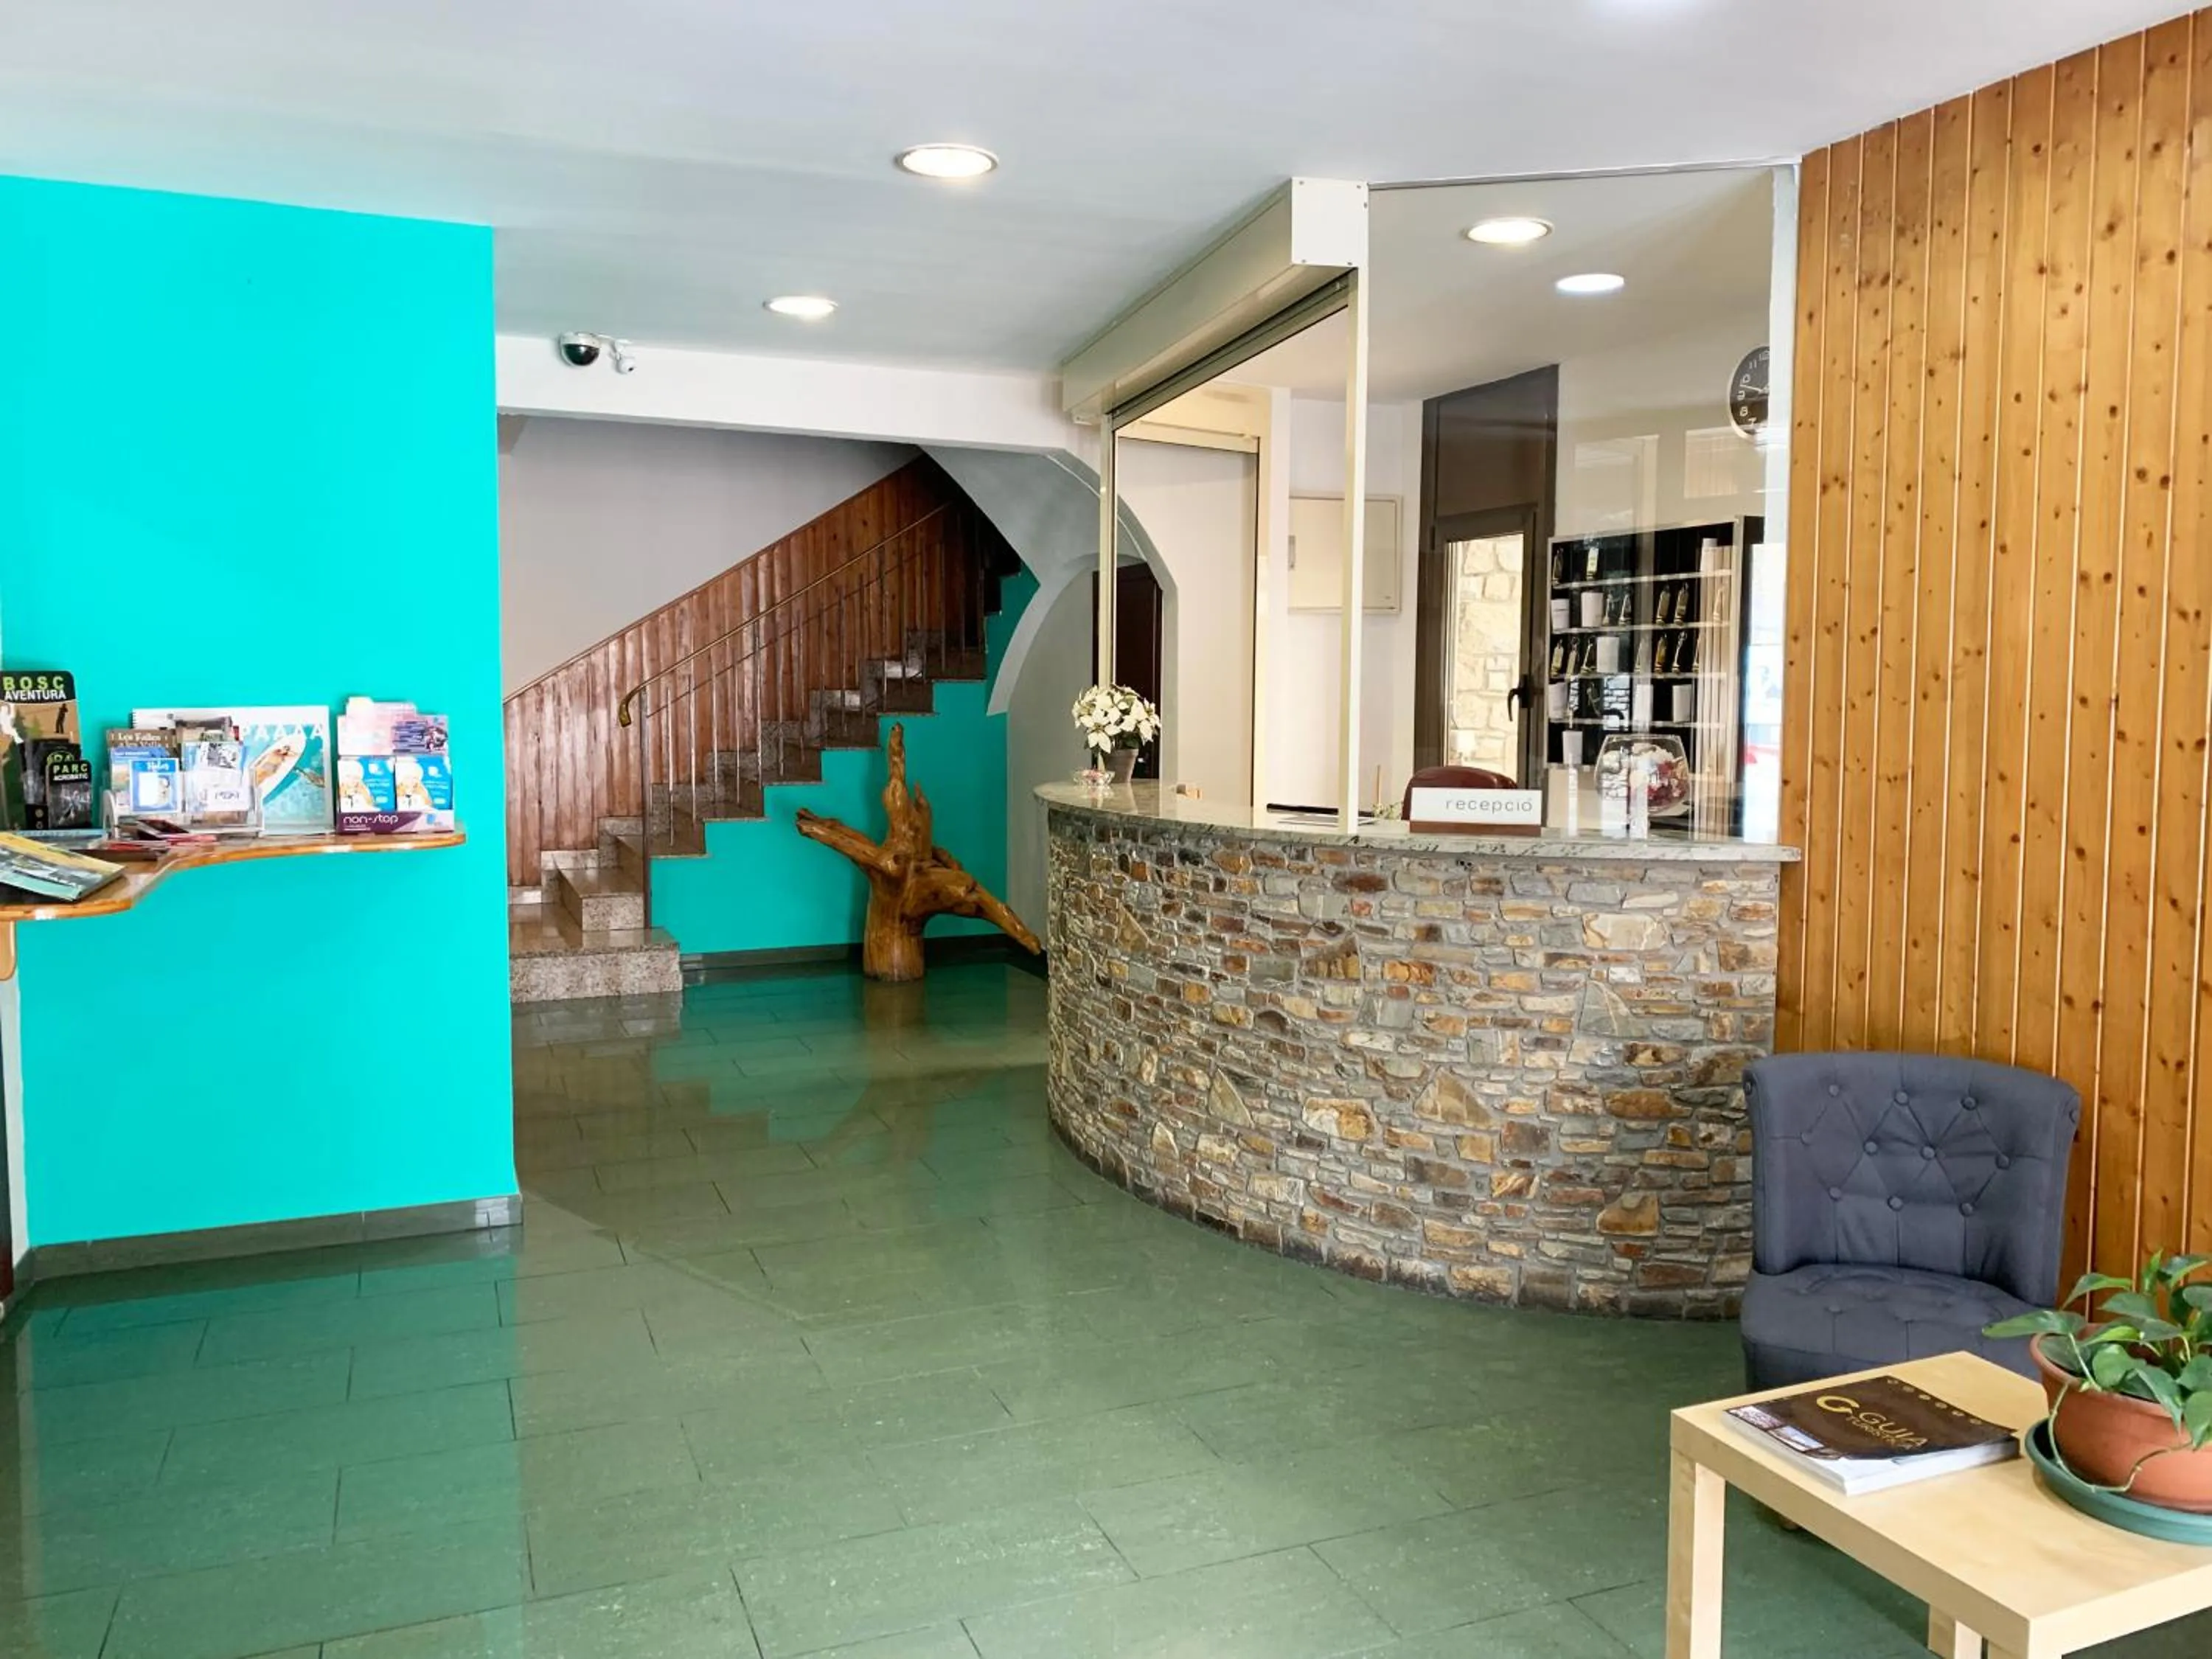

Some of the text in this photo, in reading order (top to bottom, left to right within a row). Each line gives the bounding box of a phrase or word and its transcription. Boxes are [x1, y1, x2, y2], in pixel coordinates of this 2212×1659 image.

[3, 675, 65, 691] BOSC
[4, 689, 66, 700] AVENTURA
[53, 763, 88, 773] PARC
[1446, 798, 1533, 814] recepció
[343, 814, 399, 825] non-stop
[1859, 1412, 1928, 1447] GUIA
